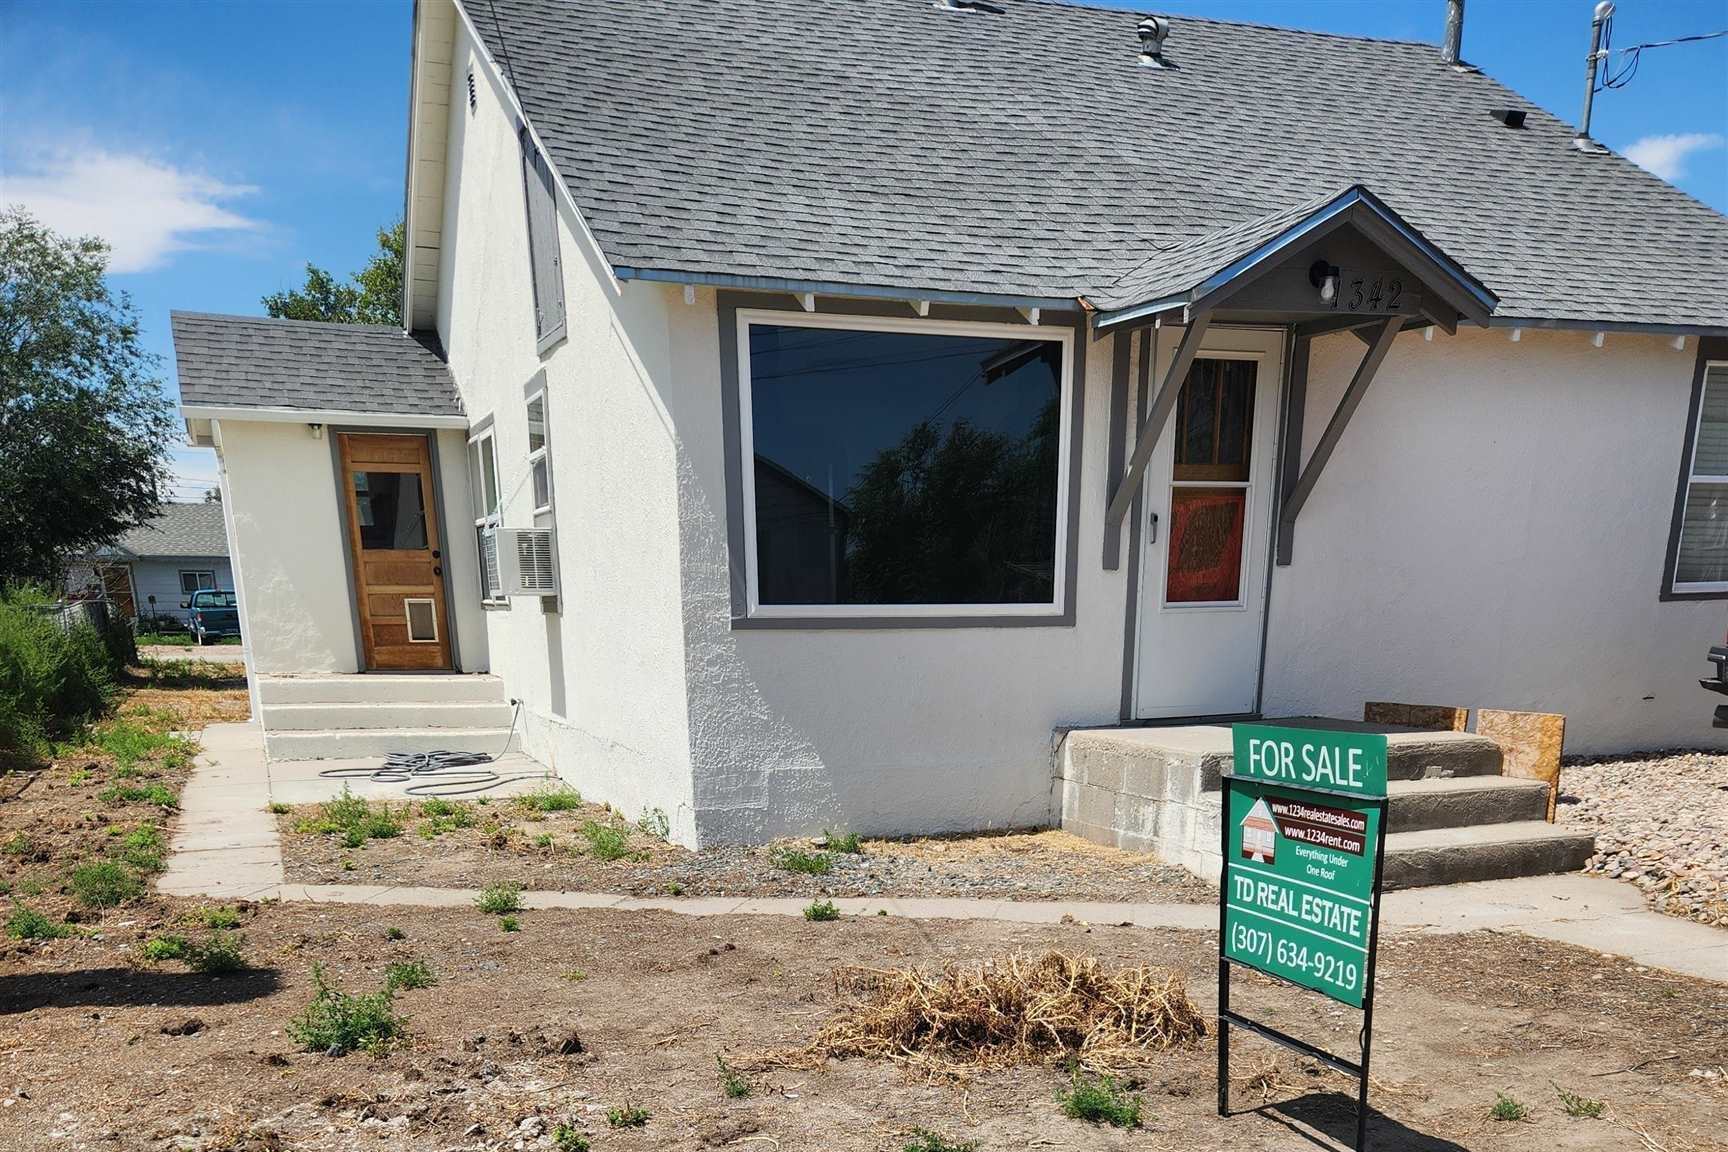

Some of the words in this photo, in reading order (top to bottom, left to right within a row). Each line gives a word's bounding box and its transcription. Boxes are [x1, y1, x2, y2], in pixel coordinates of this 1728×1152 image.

[1332, 278, 1402, 311] 1342
[1249, 739, 1296, 779] FOR
[1302, 744, 1363, 787] SALE
[1272, 803, 1365, 831] www.1234realestatesales.com
[1284, 826, 1361, 853] www.1234rent.com
[1295, 845, 1329, 863] Everything
[1329, 852, 1349, 867] Under
[1306, 864, 1320, 876] One
[1320, 867, 1336, 881] Roof
[1234, 874, 1254, 903] TD
[1256, 881, 1299, 917] REAL
[1301, 894, 1362, 938] ESTATE
[1232, 922, 1273, 965] (307)
[1276, 939, 1357, 990] 634-9219
